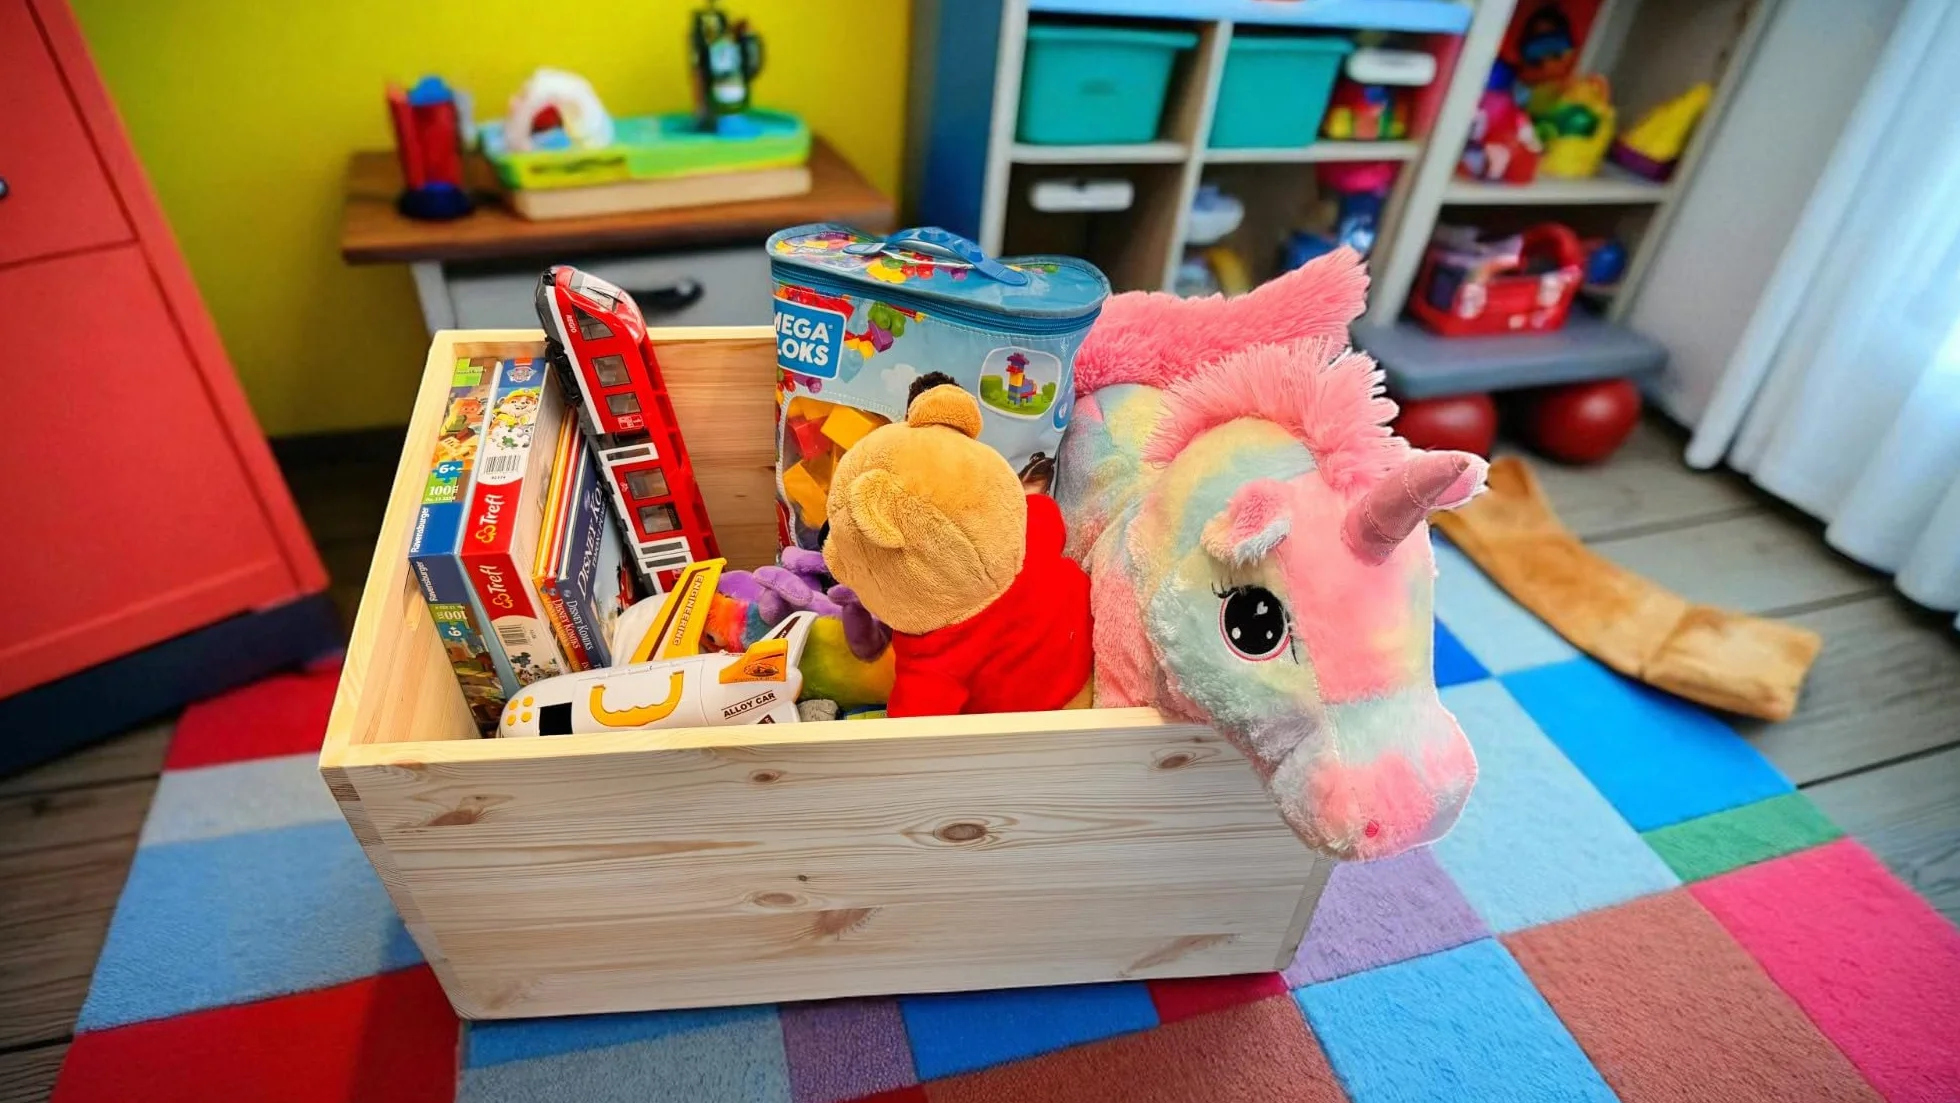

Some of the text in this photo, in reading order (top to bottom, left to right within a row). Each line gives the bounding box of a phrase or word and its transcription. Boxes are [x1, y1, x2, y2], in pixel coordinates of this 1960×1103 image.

[566, 314, 577, 333] REGIO
[777, 338, 829, 366] OKS
[479, 493, 505, 526] Trefl
[590, 481, 602, 523] KO
[479, 565, 507, 594] Trefl
[552, 599, 569, 624] DISNEY
[564, 623, 580, 649] KOMIKS
[566, 600, 583, 624] DISNEY
[577, 625, 594, 651] KOMIKS
[673, 575, 704, 646] ENGINEERING
[723, 692, 776, 717] ALLOY CAR
